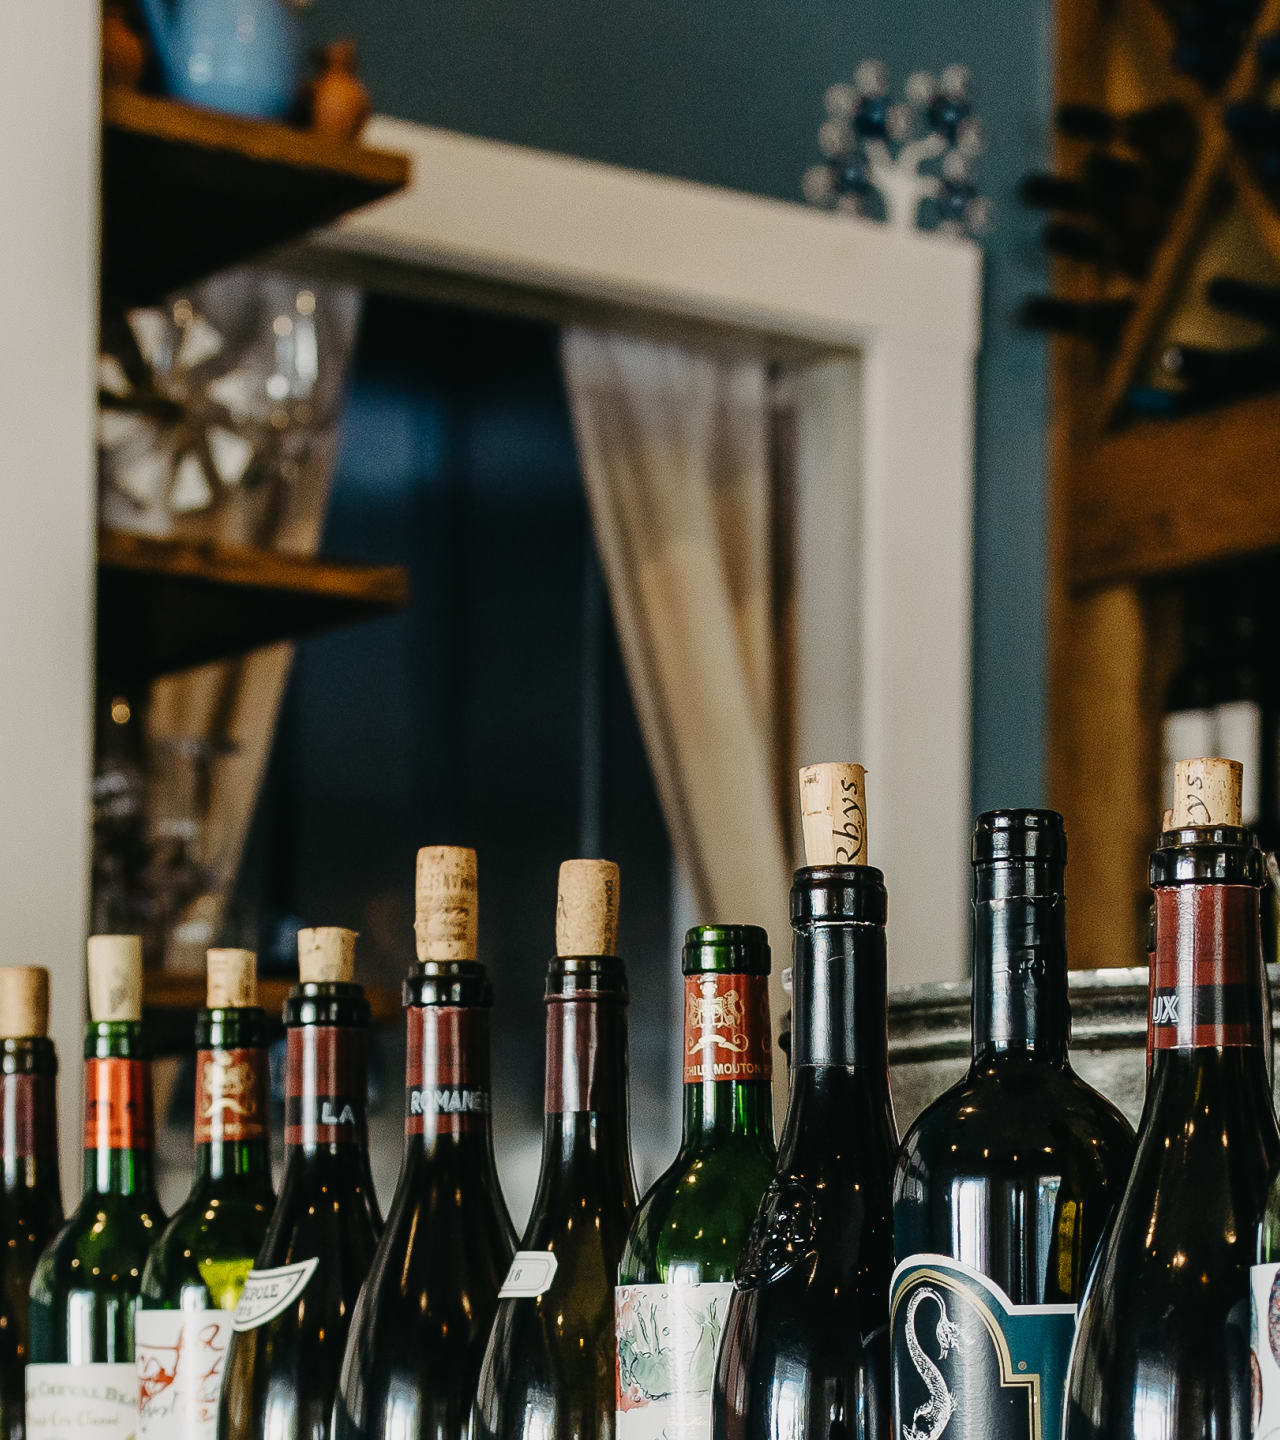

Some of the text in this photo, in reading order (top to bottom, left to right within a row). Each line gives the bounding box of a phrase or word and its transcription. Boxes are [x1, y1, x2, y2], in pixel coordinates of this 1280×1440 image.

[1186, 774, 1211, 825] ys
[1152, 995, 1180, 1024] UX
[321, 1101, 356, 1125] LA
